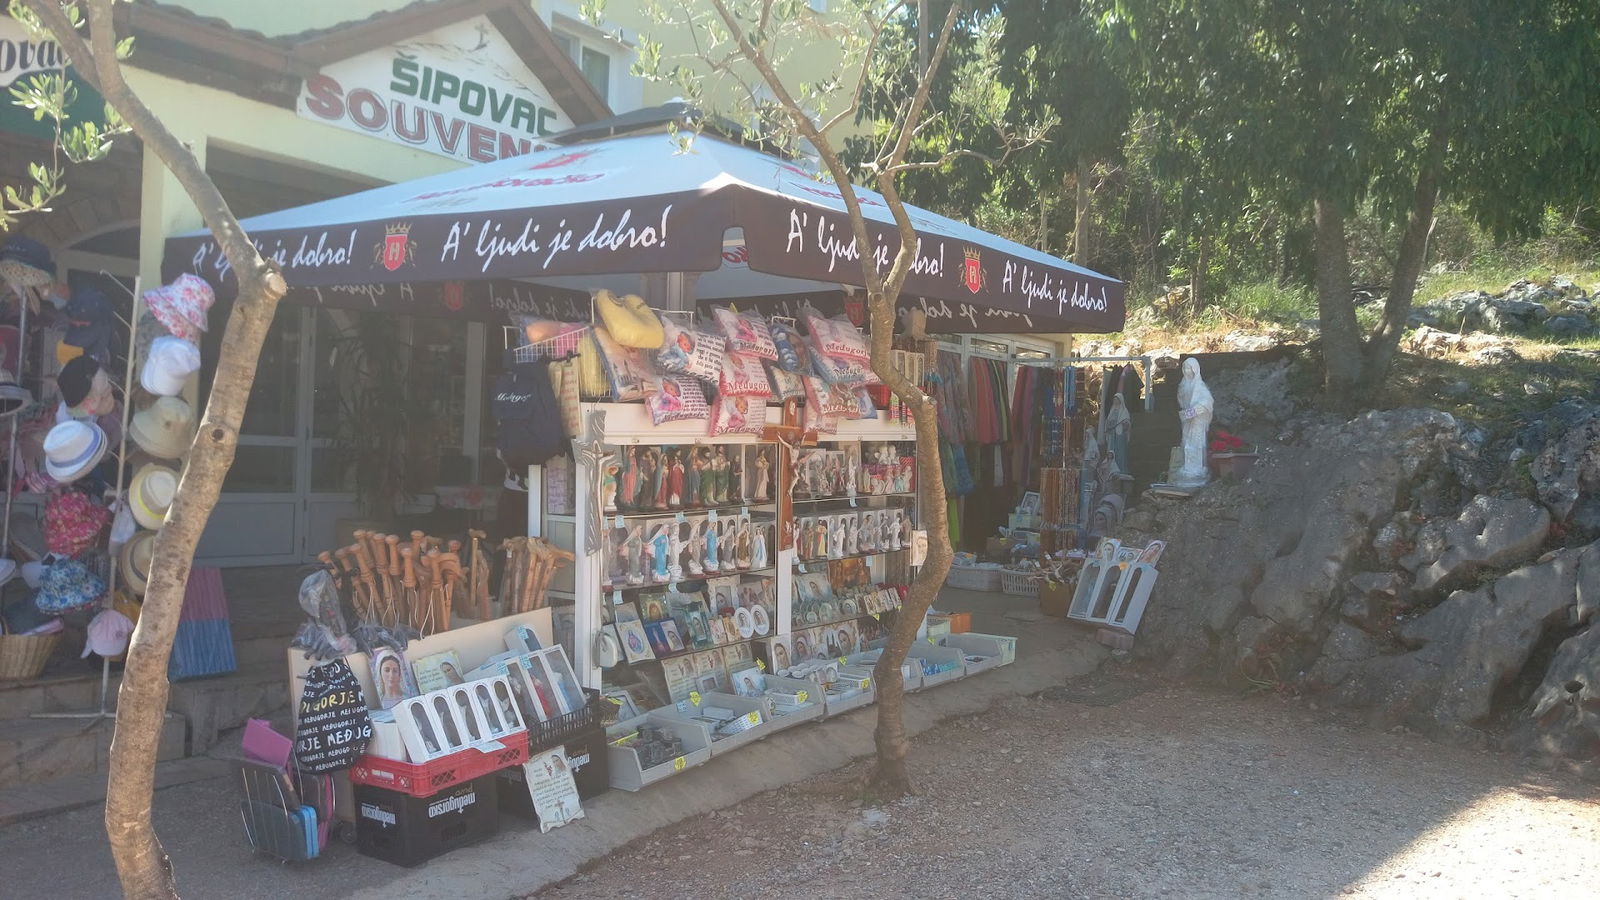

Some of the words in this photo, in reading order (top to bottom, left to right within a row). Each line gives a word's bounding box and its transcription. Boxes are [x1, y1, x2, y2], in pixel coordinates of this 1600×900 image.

[305, 73, 551, 163] SOUVEN
[389, 50, 559, 137] ŠIPOVAC
[292, 229, 357, 268] dobro!
[476, 218, 540, 273] ljudi
[543, 219, 572, 269] je
[578, 204, 673, 251] dobro!
[817, 215, 860, 273] ljud
[873, 233, 889, 273] je
[906, 238, 944, 278] bro!
[1021, 265, 1053, 309] ljudi
[1057, 280, 1068, 316] je
[1071, 281, 1108, 313] dobro!
